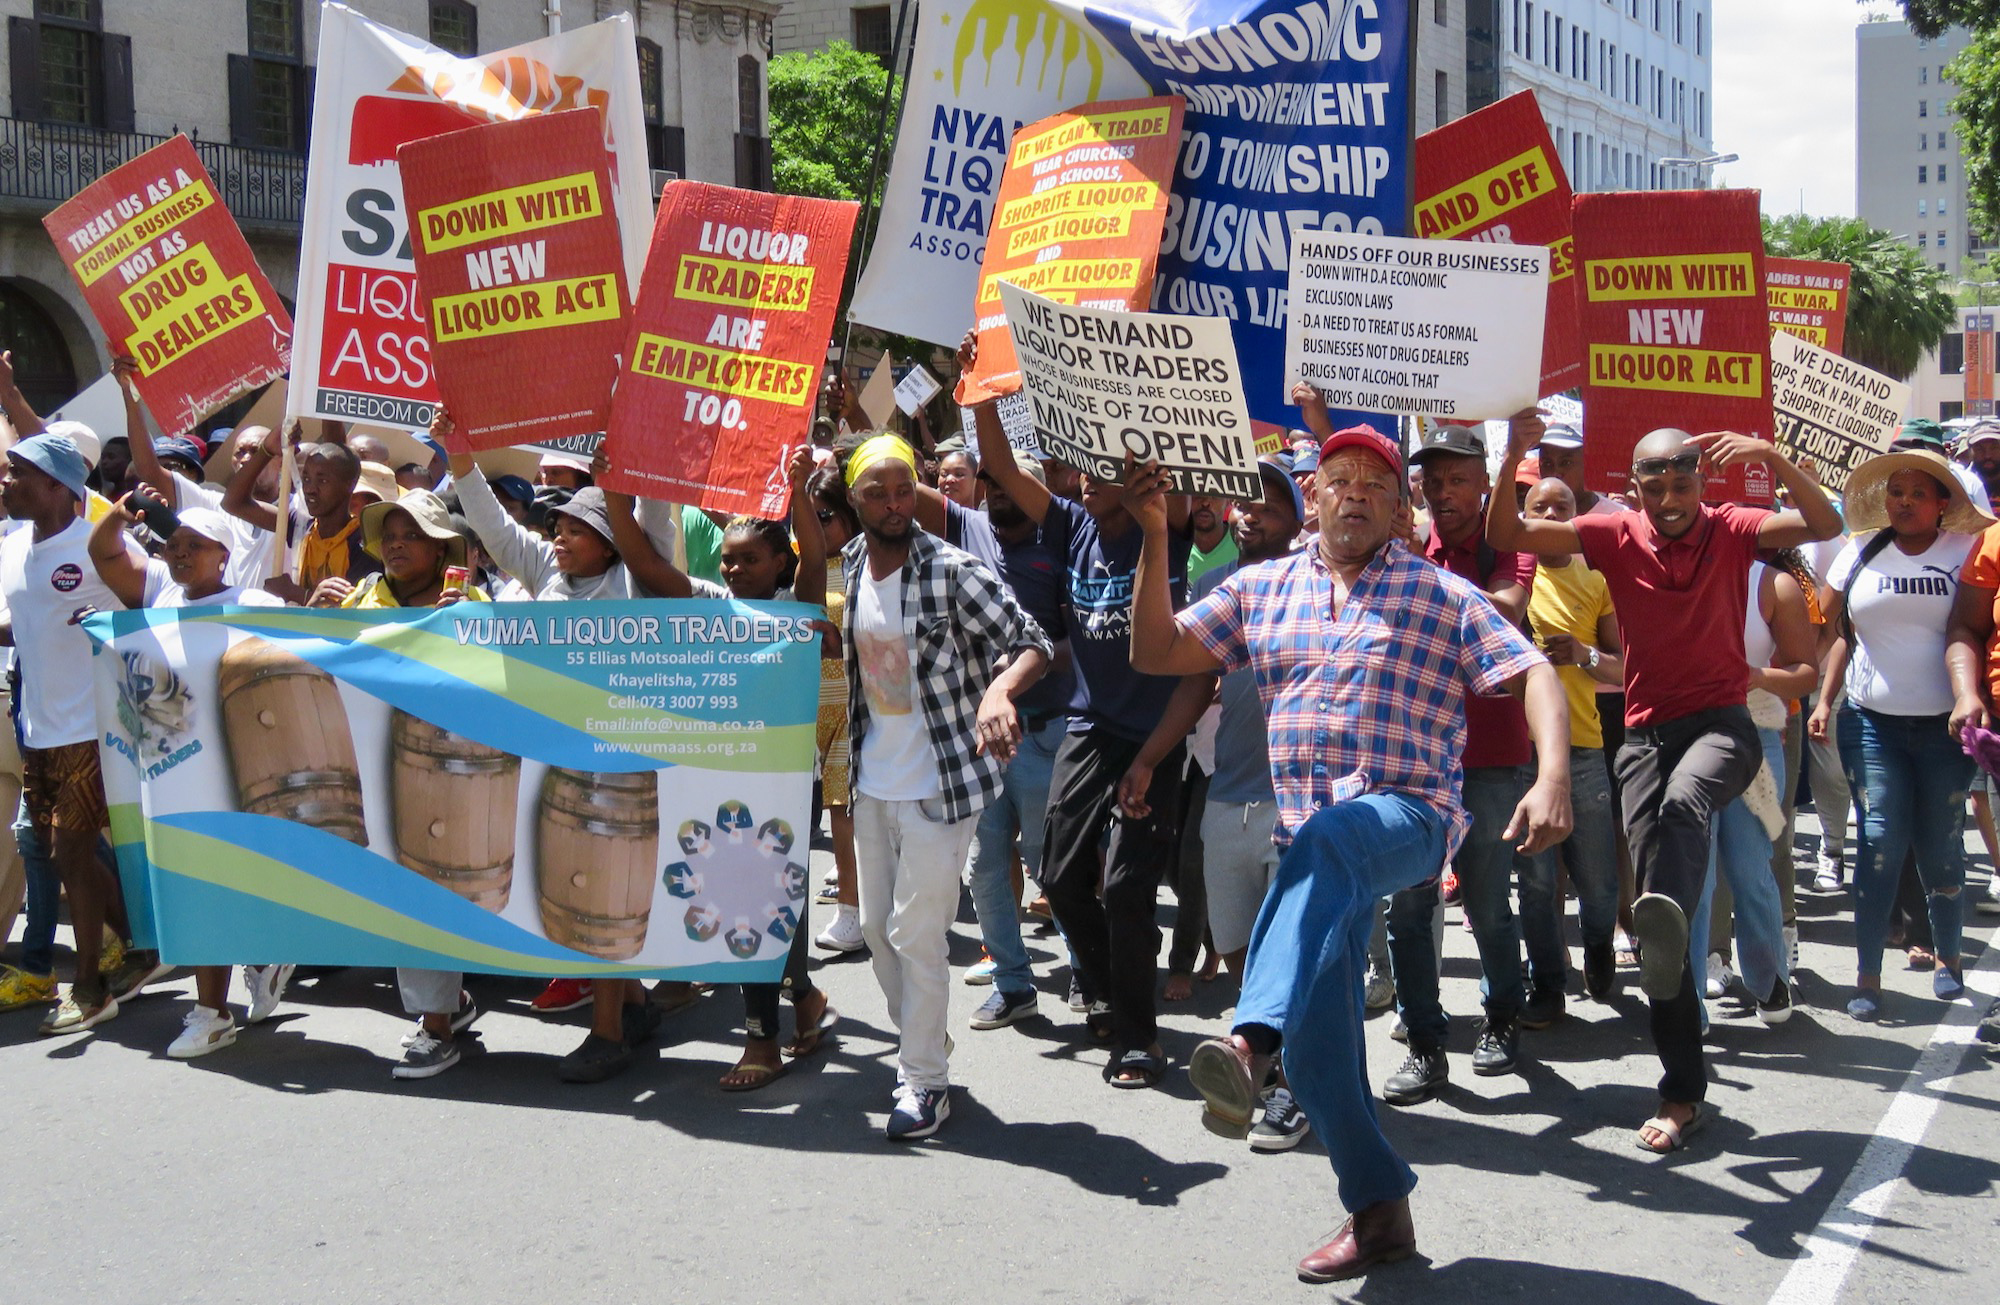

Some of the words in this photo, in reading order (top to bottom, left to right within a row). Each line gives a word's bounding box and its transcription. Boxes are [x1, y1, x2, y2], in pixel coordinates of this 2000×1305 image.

[931, 104, 1023, 154] NYA
[1017, 143, 1031, 161] IF
[1035, 136, 1054, 155] WE
[1058, 122, 1102, 146] CAN'T
[1108, 117, 1163, 137] TRADE
[924, 145, 994, 196] LIQ
[1032, 155, 1062, 178] NEAR
[1064, 145, 1135, 166] CHURCHES
[1032, 176, 1057, 195] AND
[1060, 166, 1123, 185] SCHOOLS,
[1217, 137, 1389, 198] TOWNSHIP
[68, 210, 118, 254] TREAT
[120, 194, 143, 220] US
[147, 178, 172, 206] AS
[176, 168, 193, 190] A
[427, 198, 507, 243] DOWN
[517, 185, 592, 222] WITH
[920, 187, 985, 237] TRA
[1003, 190, 1070, 226] SHOPRITE
[1077, 185, 1147, 207] LIQUOR
[1418, 192, 1480, 239] AND
[1488, 162, 1540, 206] OFF
[81, 233, 134, 275] FORMAL
[136, 192, 204, 240] BUSINESS
[699, 221, 809, 265] LIQUOR
[909, 231, 984, 266] ASSOC
[1012, 225, 1048, 249] SPAR
[1053, 216, 1121, 238] LIQUOR
[119, 246, 157, 284] NOT
[160, 231, 188, 261] AS
[465, 240, 546, 290] NEW
[1035, 245, 1061, 264] AND
[1062, 263, 1134, 283] LIQUOR
[1300, 243, 1358, 261] HANDS
[1362, 247, 1393, 264] OFF
[1397, 251, 1432, 267] OUR
[1438, 254, 1539, 274] BUSINESSES
[129, 259, 207, 321] DRUG
[338, 270, 426, 322] LIQU
[683, 260, 808, 305] TRADERS
[1306, 264, 1339, 281] DOWN
[1341, 267, 1368, 283] WITH
[1370, 269, 1388, 284] D.A
[1390, 271, 1448, 289] ECONOMIC
[1594, 264, 1673, 292] DOWN
[1681, 263, 1747, 292] WITH
[1766, 272, 1800, 286] ADERS
[1804, 275, 1830, 289] WAR
[1833, 279, 1843, 290] IS
[439, 290, 544, 336] LIQUOR
[555, 278, 607, 315] ACT
[1169, 279, 1238, 320] OUR
[1246, 287, 1288, 329] LIF
[1305, 288, 1362, 307] EXCLUSION
[1365, 293, 1393, 310] LAWS
[1783, 312, 1809, 325] WAR
[1812, 315, 1823, 326] IS
[1794, 293, 1833, 311] WAR,
[137, 285, 253, 369] DEALERS
[706, 314, 767, 350] ARE
[978, 313, 1008, 332] SHOU
[1022, 297, 1055, 334] WE
[1059, 313, 1193, 350] DEMAND
[1303, 313, 1321, 329] D.A
[1324, 315, 1350, 331] NEED
[1352, 317, 1366, 332] TO
[1368, 318, 1399, 336] TREAT
[1401, 322, 1415, 337] US
[1417, 323, 1431, 338] AS
[1433, 325, 1478, 342] FORMAL
[1628, 309, 1704, 345] NEW
[330, 328, 436, 390] ASS
[639, 342, 806, 395] EMPLOYERS
[1012, 321, 1095, 372] LIQUOR
[1100, 350, 1229, 384] TRADERS
[1303, 338, 1364, 358] BUSINESSES
[1366, 343, 1388, 359] NOT
[1390, 345, 1419, 363] DRUG
[1422, 348, 1469, 367] DEALERS
[1596, 353, 1693, 384] LIQUOR
[1704, 354, 1753, 385] ACT
[1793, 345, 1819, 369] WE
[1820, 358, 1891, 400] DEMAND
[1021, 351, 1057, 379] WHOSE
[1060, 370, 1132, 396] BUSINESSES
[1137, 385, 1166, 399] ARE
[1169, 387, 1232, 403] CLOSED
[1301, 362, 1336, 379] DRUGS
[1338, 366, 1360, 382] NOT
[1362, 369, 1409, 387] ALCOHOL
[1412, 373, 1439, 389] THAT
[325, 394, 411, 423] FREEDOM
[683, 391, 747, 431] TOO.
[1001, 404, 1029, 419] TRADE
[1025, 371, 1099, 415] BECAUSE
[1104, 399, 1133, 421] OF
[1140, 404, 1237, 429] ZONING
[1357, 392, 1379, 408] OUR
[1381, 394, 1455, 415] COMMUNITIES
[1780, 389, 1836, 425] SHOPRITE
[1836, 413, 1882, 444] LIQOURS
[1801, 374, 1826, 398] PICK
[1829, 386, 1840, 401] N
[1839, 391, 1861, 415] PAY,
[1862, 401, 1898, 428] BOXER
[490, 421, 517, 431] ECONOMIC
[518, 417, 550, 427] REVOLUTION
[1031, 395, 1107, 452] MUST
[1120, 428, 1247, 468] OPEN!
[1795, 423, 1849, 463] FOKOF
[624, 468, 646, 478] RADICAL
[647, 472, 677, 484] ECONOMIC
[1041, 434, 1116, 480] ZONING
[1190, 472, 1253, 498] FALL!
[1877, 576, 1949, 596] PUMA
[454, 618, 541, 645] VUMA
[547, 616, 661, 645] LIQUOR
[668, 614, 815, 645] TRADERS
[566, 651, 585, 665] 55
[589, 650, 626, 665] Ellias
[631, 650, 714, 665] Motsoaledi
[718, 650, 783, 665] Crescent
[608, 672, 698, 690] Khayelitsha,
[701, 673, 737, 687] 7785
[607, 694, 666, 709] Cell:073
[669, 695, 705, 709] 3007
[709, 695, 738, 709] 993
[585, 717, 765, 733] Email:info@vuma.co.za
[147, 739, 203, 780] TRADERS
[593, 740, 757, 755] www.vumaass.org.za
